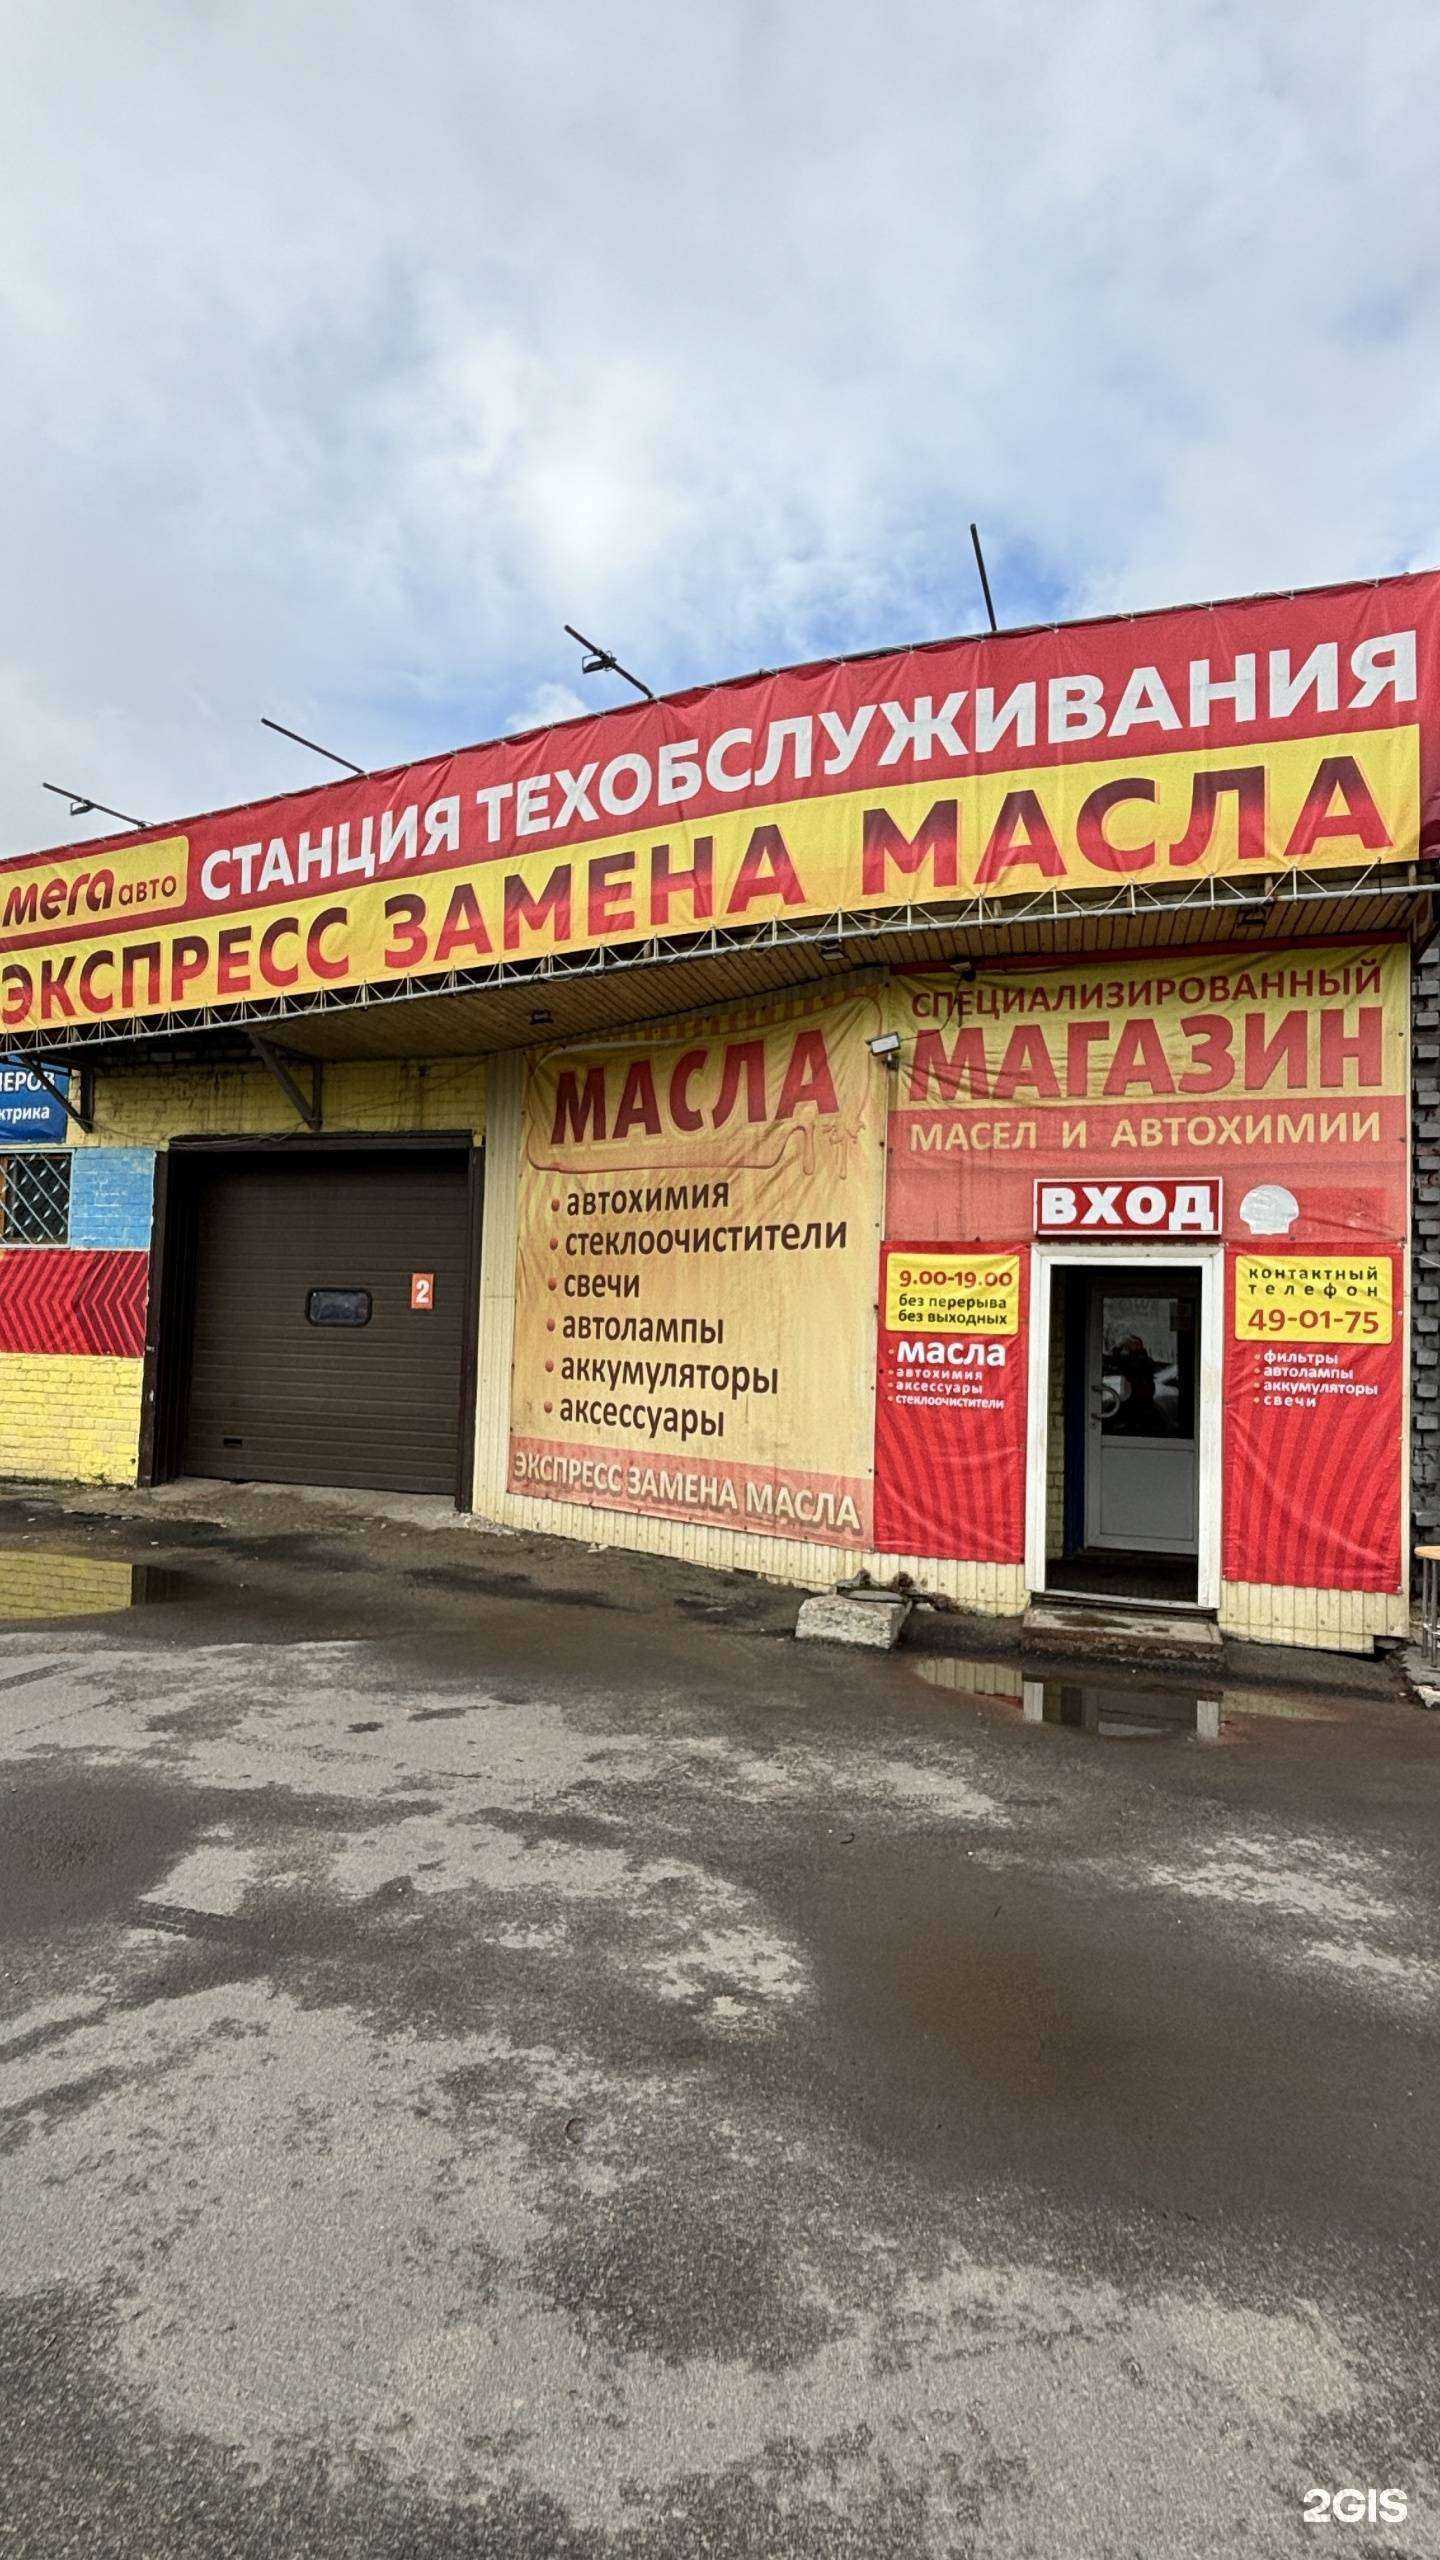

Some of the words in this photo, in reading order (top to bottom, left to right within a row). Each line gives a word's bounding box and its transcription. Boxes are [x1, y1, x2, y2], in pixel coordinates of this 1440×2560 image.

[201, 795, 460, 901] СТАНЦИЯ
[477, 630, 1417, 844] ТЕХОБСЛУЖИВАНИЯ
[1, 906, 349, 1026] ЭКСПРЕСС
[384, 824, 806, 970] ЗАМЕНА
[862, 756, 1395, 895] МАСЛА
[2, 868, 115, 928] мега
[118, 876, 177, 907] авто
[911, 959, 1382, 1021] СПЕЦИАЛИЗИРОВАННЫЙ
[909, 1007, 1383, 1101] МАГАЗИН
[551, 1029, 839, 1145] МАСЛА
[910, 1121, 1037, 1153] МАСЕЛ
[1063, 1120, 1087, 1149] И
[1111, 1111, 1380, 1149] АВТОХИМИИ
[567, 1182, 729, 1216] автохимия
[1041, 1186, 1214, 1231] ВХОД
[565, 1221, 847, 1256] стеклоочистители
[564, 1273, 640, 1298] свечи
[900, 1270, 1012, 1288] 9.00-19.00
[1249, 1266, 1378, 1281] контактный
[416, 1280, 430, 1303] 2
[899, 1293, 924, 1307] без
[929, 1297, 1007, 1312] перерыва
[1248, 1283, 1378, 1299] телефон
[563, 1315, 724, 1344] автолампы
[898, 1309, 923, 1322] без
[928, 1312, 1007, 1325] выходных
[1248, 1309, 1379, 1334] 49-01-75
[897, 1340, 1006, 1366] масла
[1263, 1350, 1338, 1365] фильтры
[561, 1356, 778, 1400] аккумуляторы
[896, 1368, 983, 1381] автохимия
[1263, 1366, 1354, 1379] автолампы
[895, 1381, 983, 1395] аксессуары
[1263, 1381, 1378, 1395] аккумуляторы
[895, 1395, 1005, 1409] стеклоочистители
[1263, 1396, 1317, 1407] свечи
[559, 1399, 724, 1441] аксессуары
[514, 1452, 622, 1492] ЭКСПРЕСС
[628, 1467, 739, 1511] ЗАМЕНА
[746, 1482, 861, 1531] МАСЛА
